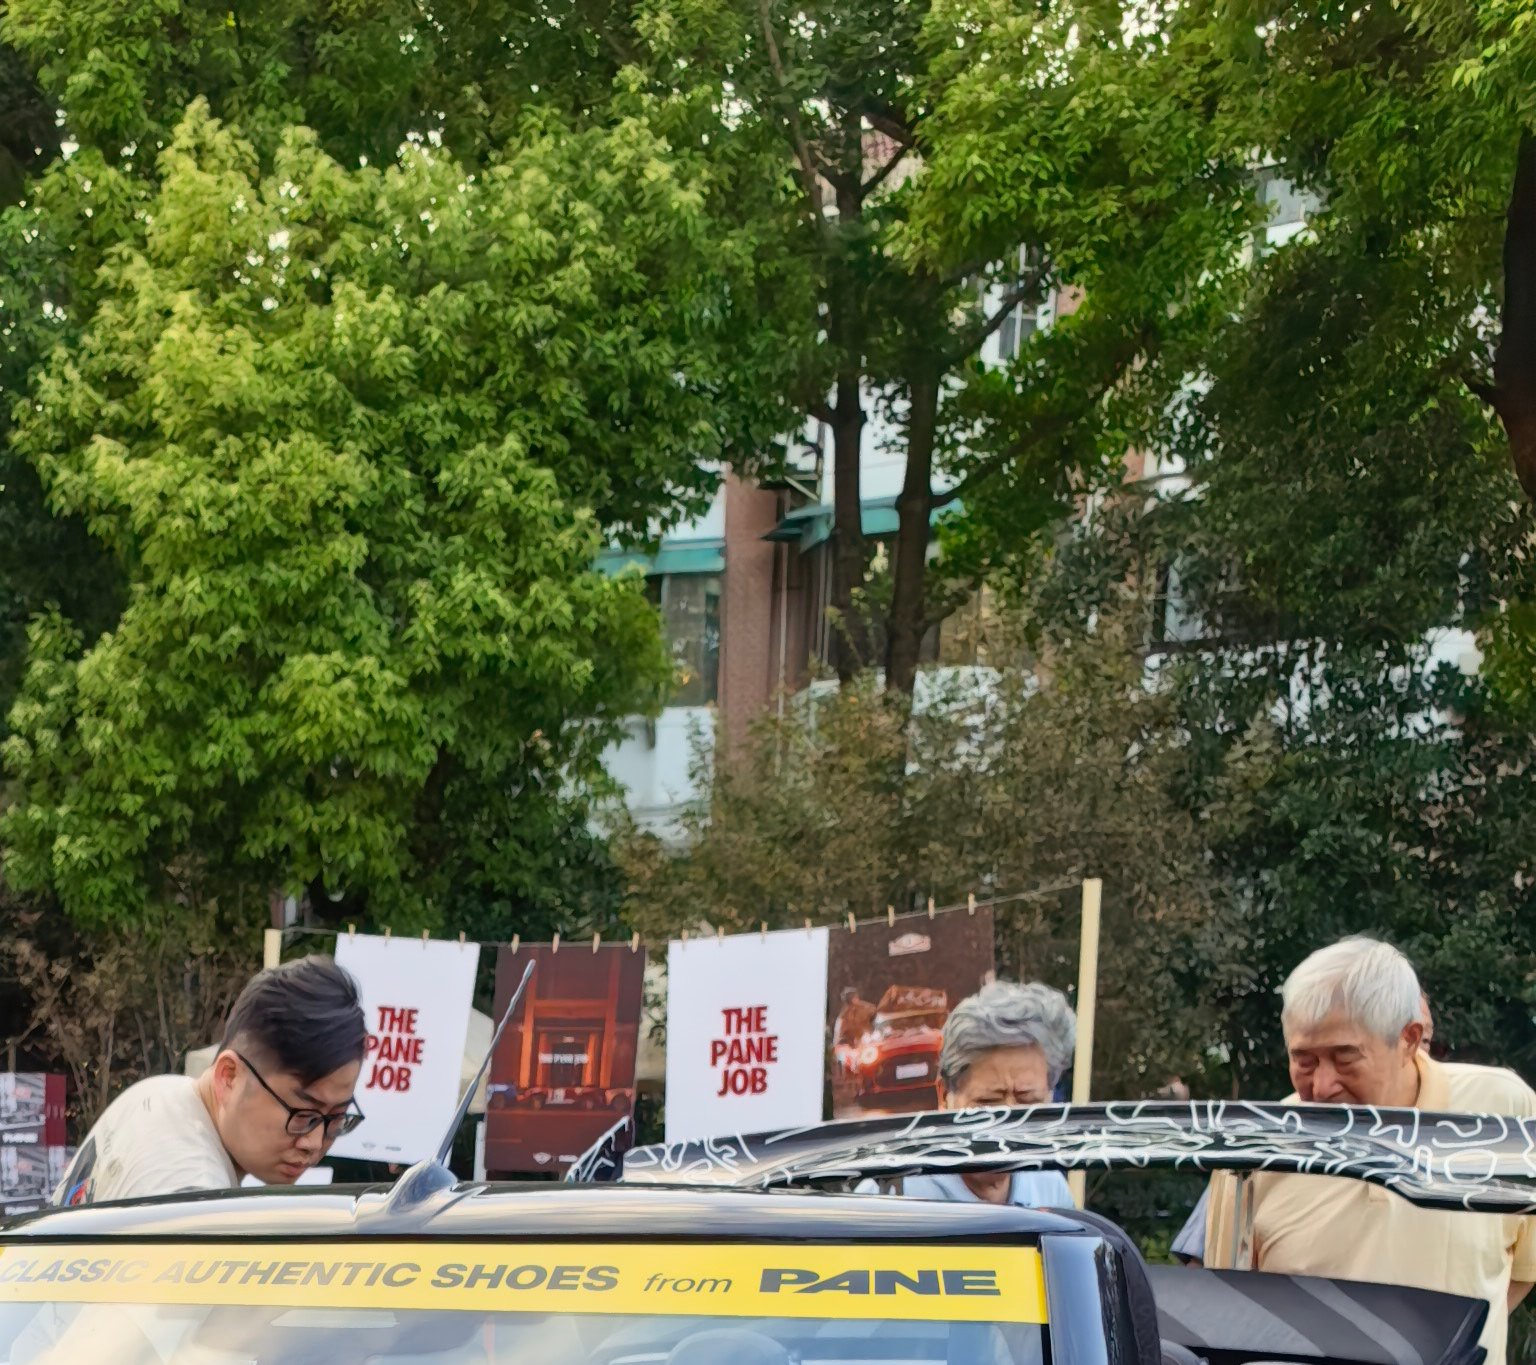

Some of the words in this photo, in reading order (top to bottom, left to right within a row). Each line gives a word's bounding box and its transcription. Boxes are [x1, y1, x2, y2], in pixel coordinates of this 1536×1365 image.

[378, 1007, 419, 1034] THE
[721, 1006, 767, 1035] THE
[366, 1035, 425, 1065] PANE
[710, 1036, 778, 1067] PANE
[365, 1065, 412, 1091] JOB
[717, 1068, 768, 1097] JOB
[0, 1259, 148, 1283] CLASSIC
[154, 1260, 433, 1287] AUTHENTIC
[430, 1263, 620, 1292] SHOES
[645, 1272, 733, 1295] from
[759, 1268, 1002, 1296] PANE
